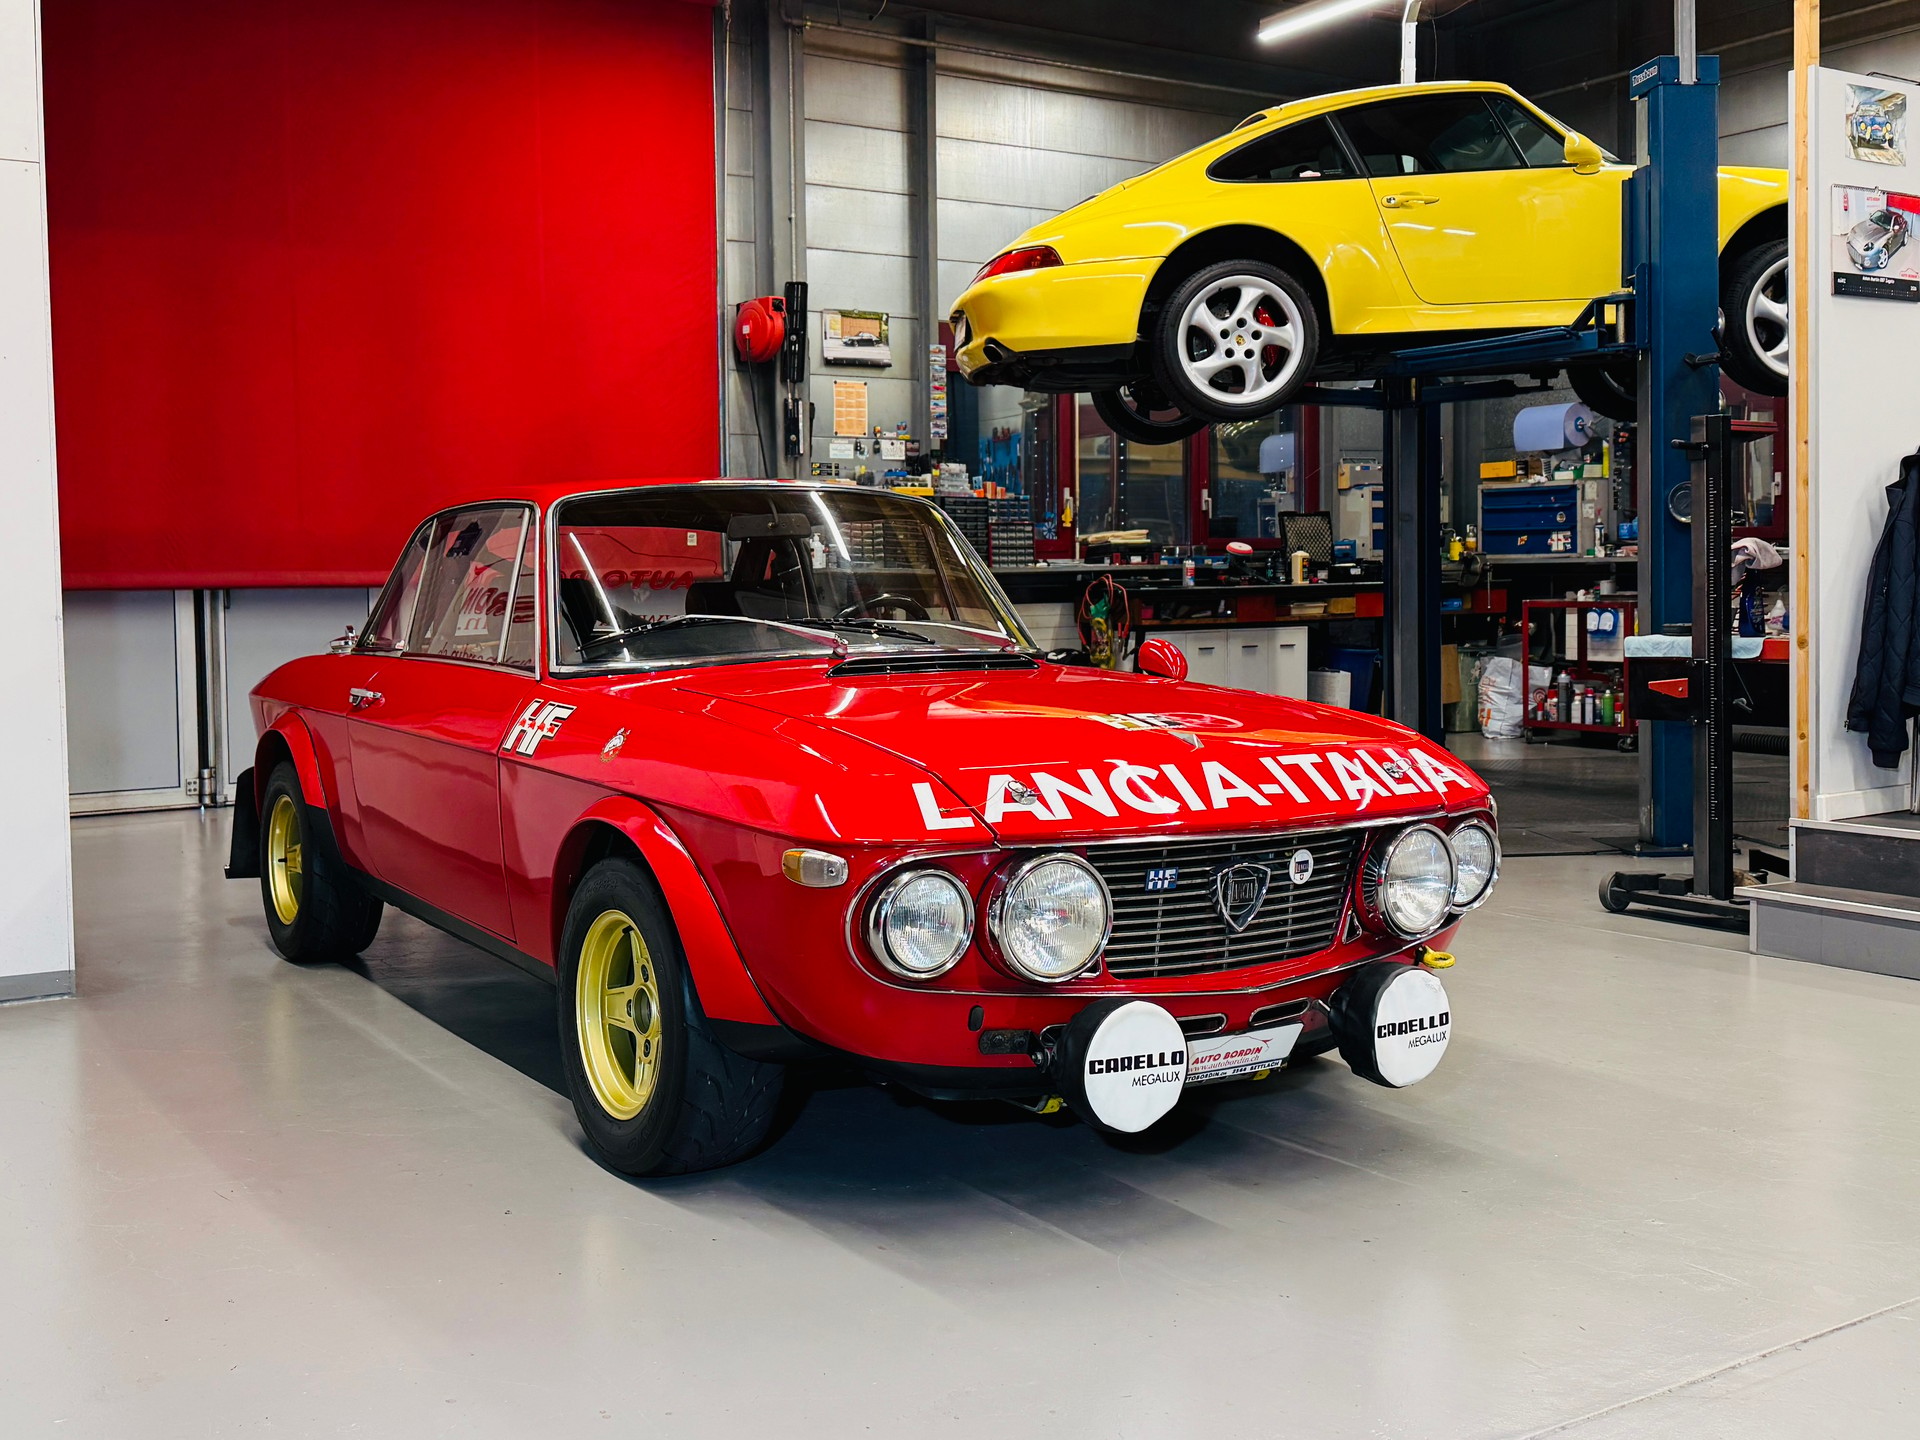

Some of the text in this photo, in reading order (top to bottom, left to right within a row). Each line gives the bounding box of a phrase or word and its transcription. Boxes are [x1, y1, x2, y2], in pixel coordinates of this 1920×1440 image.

[502, 698, 577, 757] HF
[911, 748, 1470, 831] LANCIA-ITALIA
[1148, 869, 1176, 889] HF
[1377, 1012, 1449, 1038] CARELLO
[1408, 1031, 1447, 1048] MEGALUX
[1089, 1051, 1184, 1074] CARELLO
[1192, 1047, 1263, 1065] AUTO BORDIN
[1132, 1071, 1180, 1087] MEGALUX
